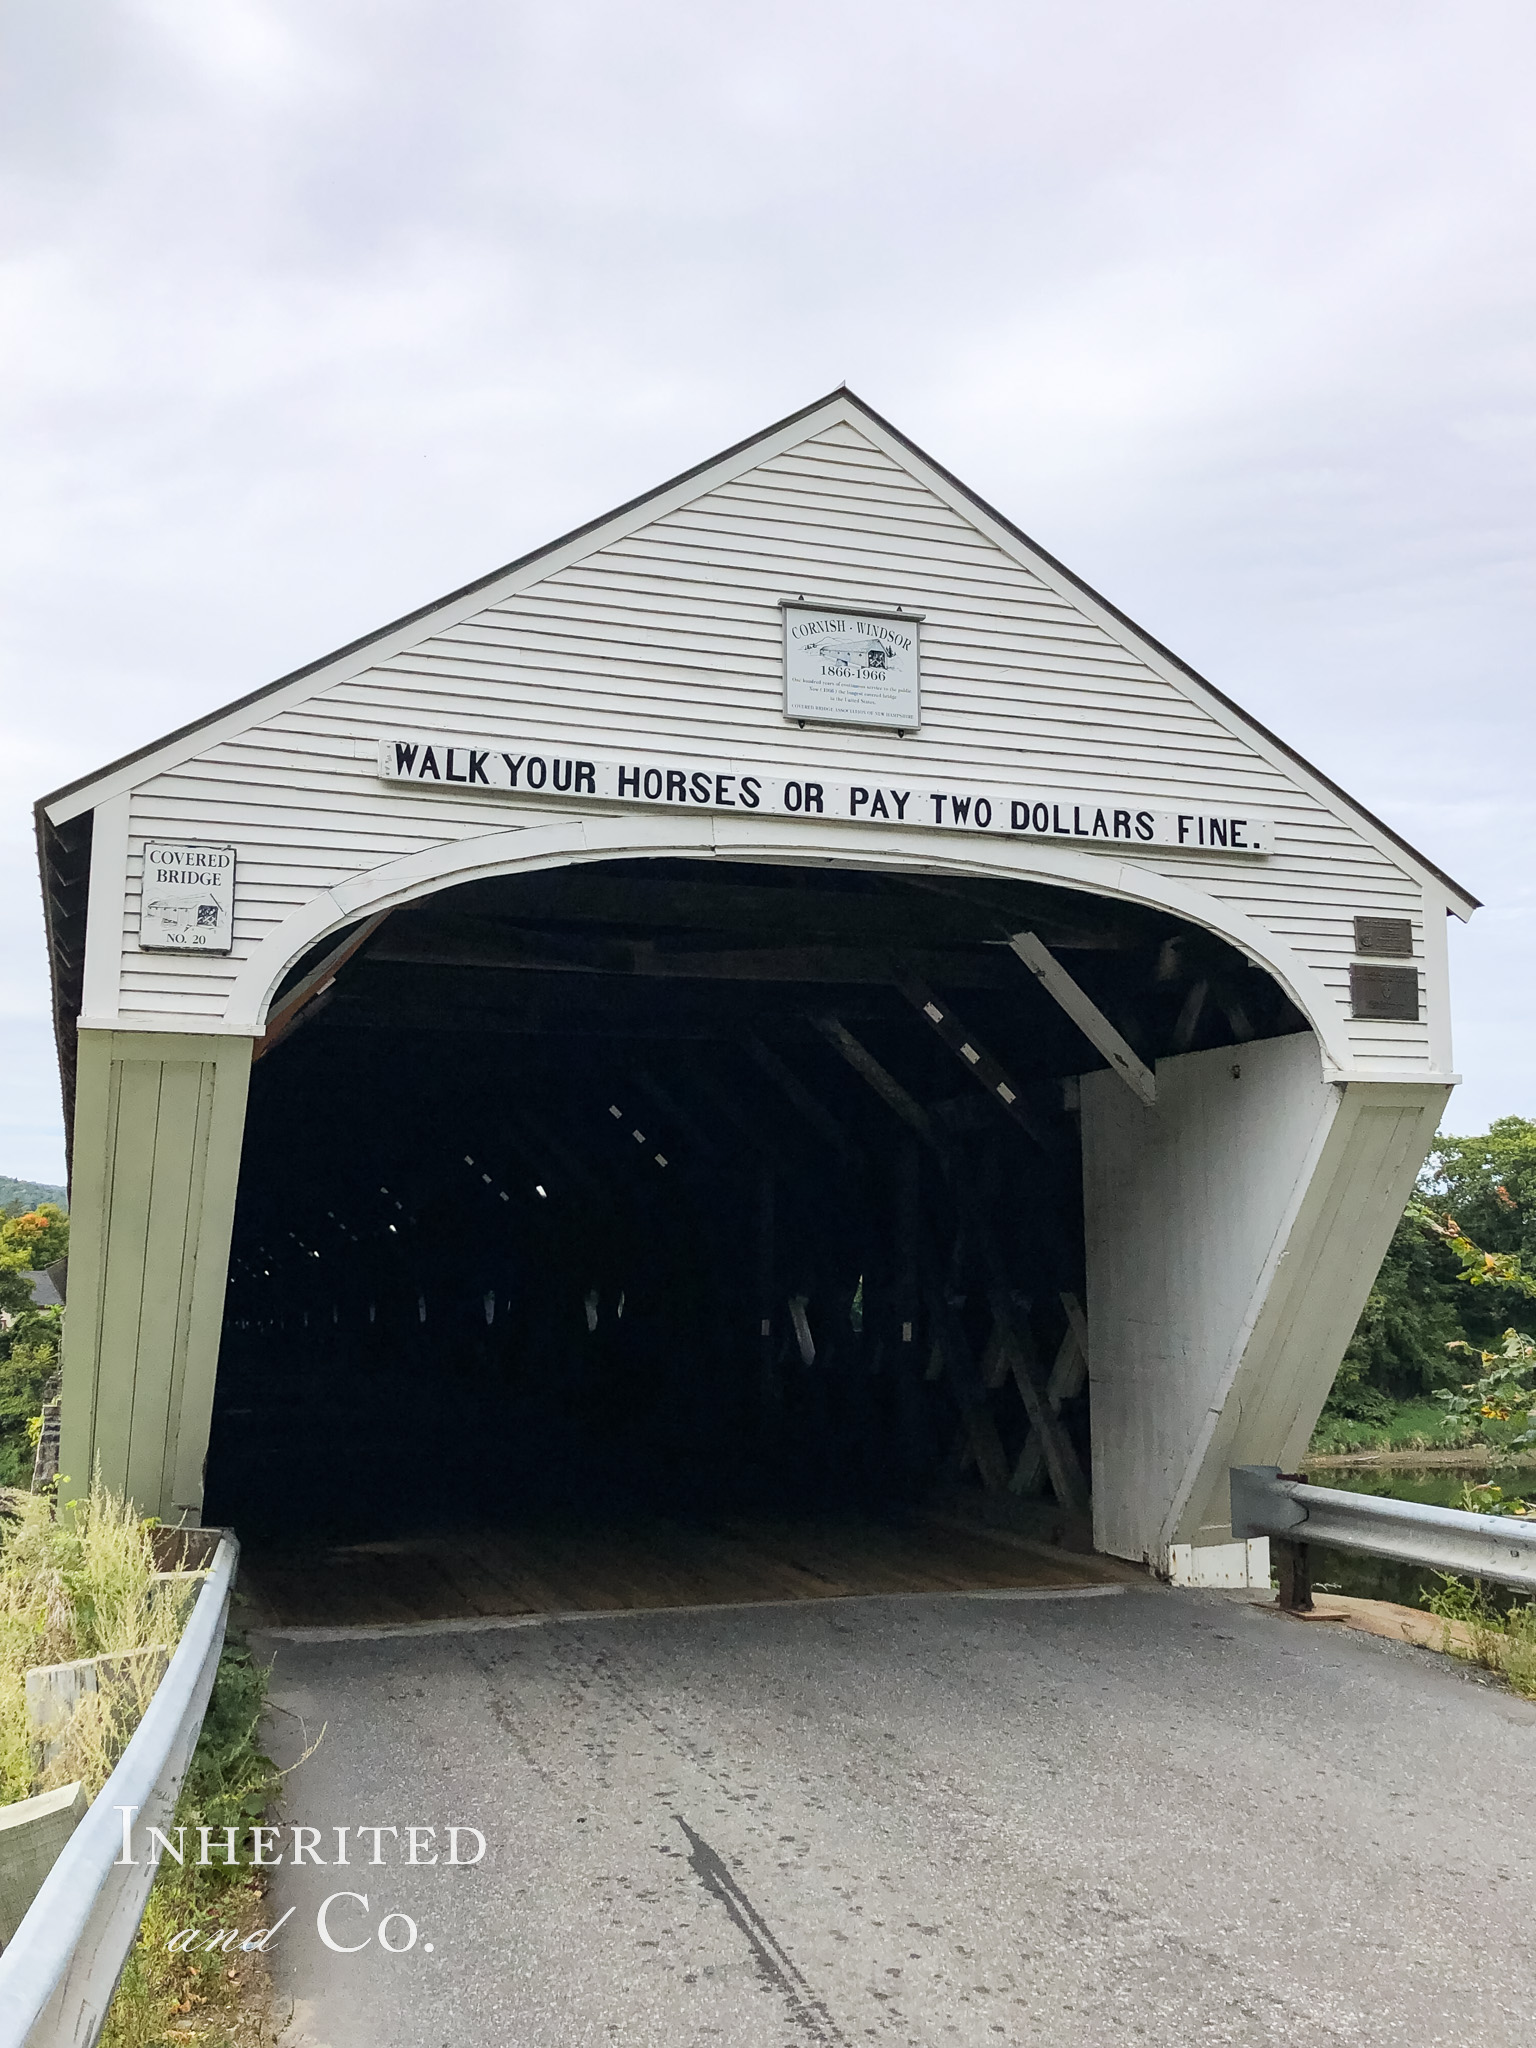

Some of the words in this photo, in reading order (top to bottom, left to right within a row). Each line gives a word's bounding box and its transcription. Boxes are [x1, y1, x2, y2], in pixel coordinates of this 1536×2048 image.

[792, 620, 846, 639] CORNISH
[857, 622, 912, 651] WINDSOR
[821, 665, 886, 681] 1866-1966
[395, 743, 490, 786] WALK
[501, 754, 596, 794] YOUR
[618, 765, 762, 809] HORSES
[784, 781, 824, 813] OR
[849, 787, 910, 820] PAY
[930, 794, 992, 828] TWO
[1011, 801, 1155, 841] DOLLARS
[1177, 814, 1261, 849] FINE.
[150, 850, 230, 868] COVERED
[156, 869, 222, 886] BRIDGE
[166, 933, 187, 944] NO.
[192, 934, 206, 945] 20
